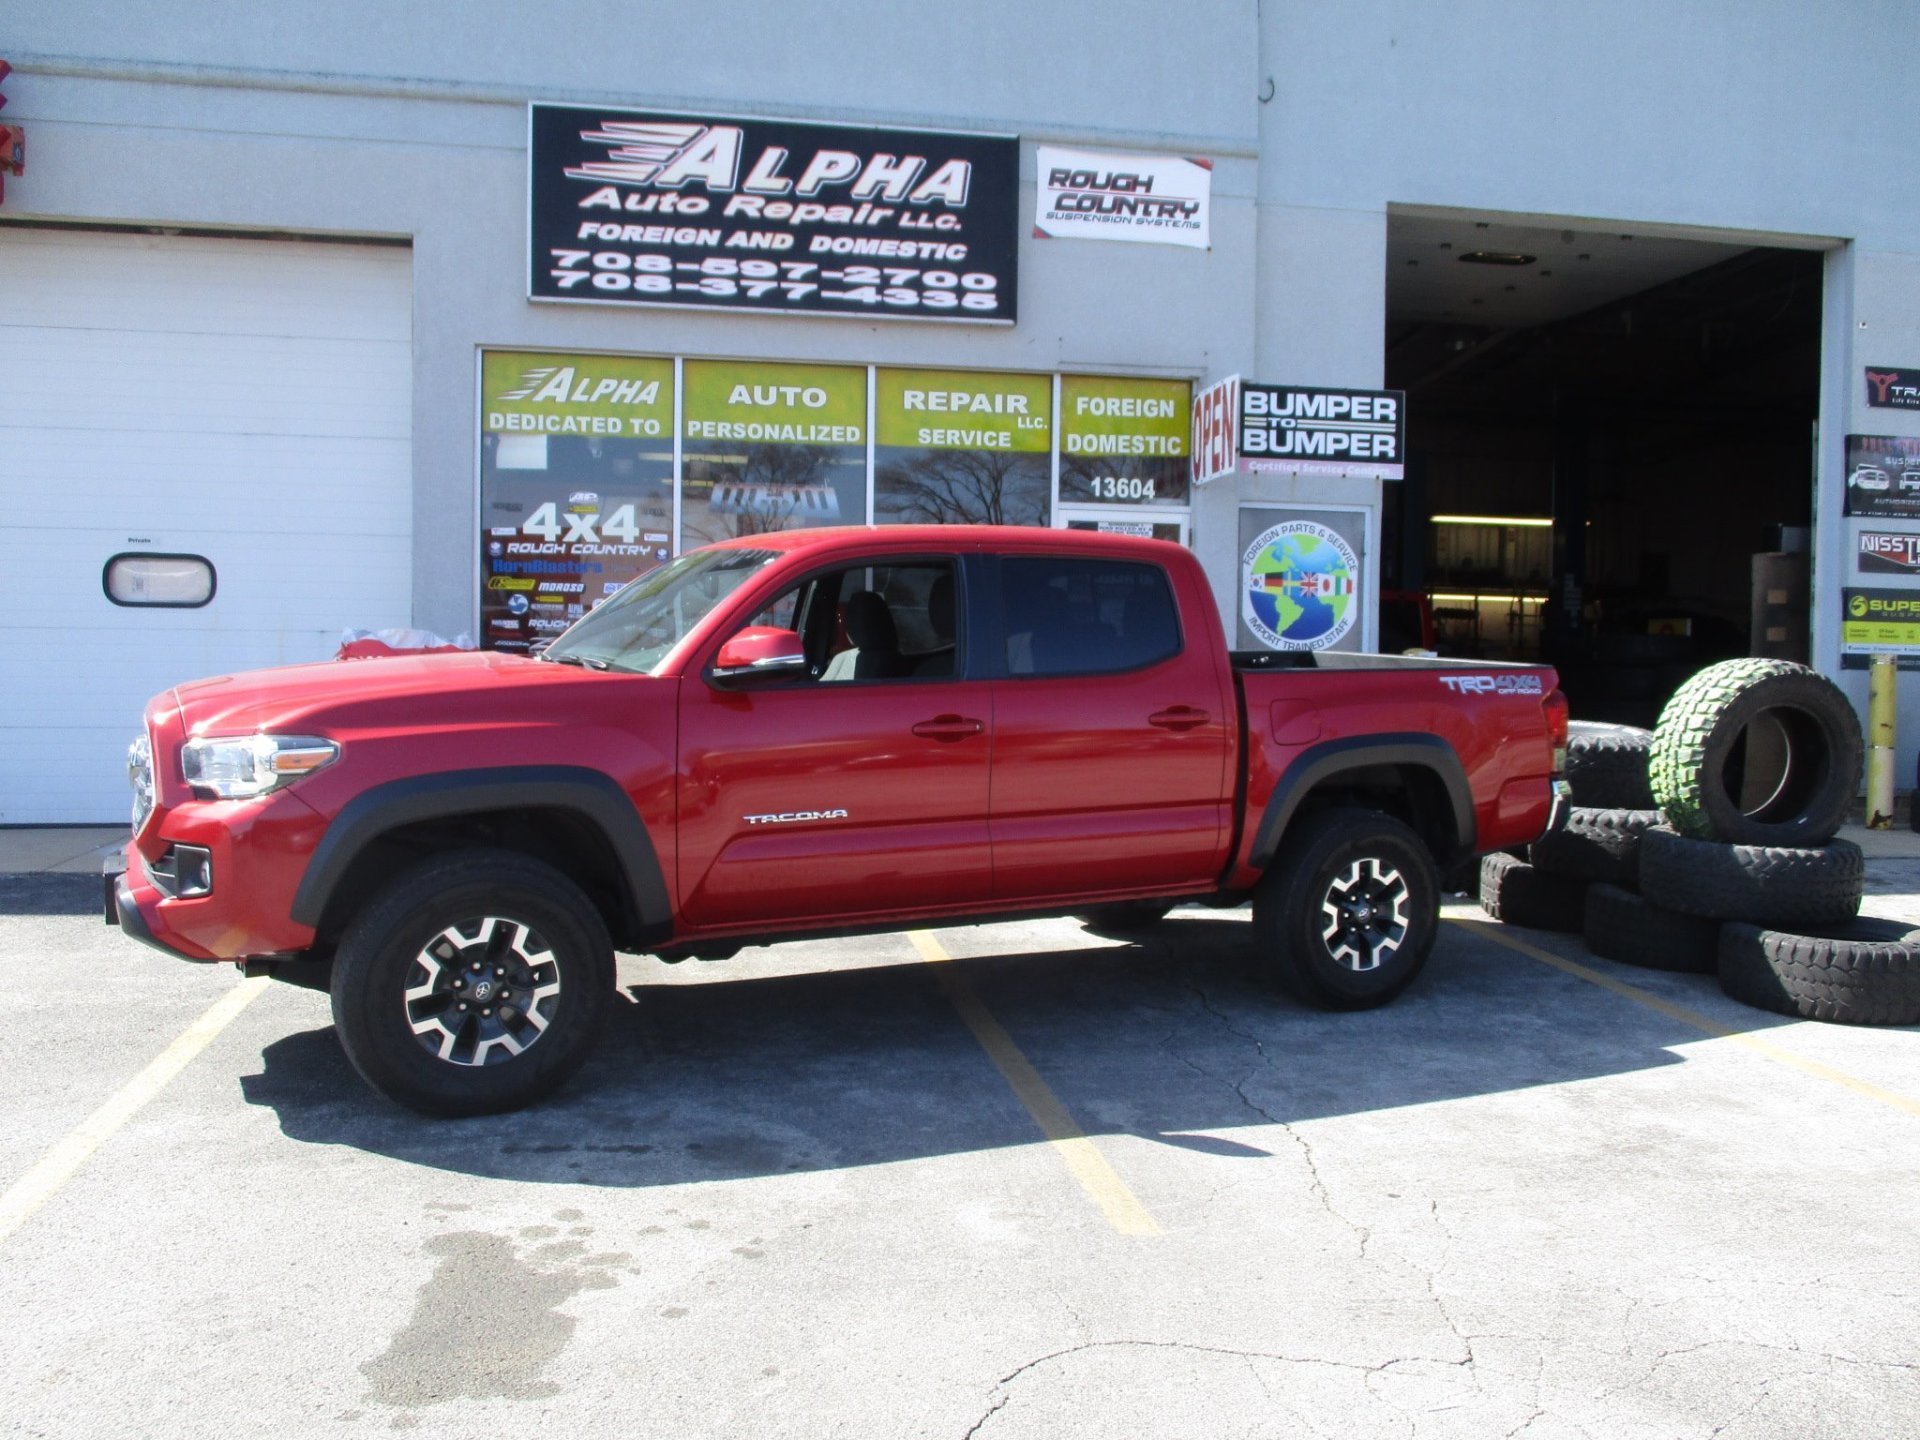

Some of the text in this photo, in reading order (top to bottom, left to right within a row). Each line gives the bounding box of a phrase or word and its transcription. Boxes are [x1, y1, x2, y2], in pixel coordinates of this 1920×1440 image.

[654, 124, 971, 206] ALPHA
[1048, 167, 1155, 193] ROUGH
[579, 187, 962, 231] Auto Repair LLC.
[1054, 192, 1200, 220] COUNTRY
[1045, 211, 1201, 230] SUSPENSION SYSTEMS
[578, 223, 968, 261] FOREIGN AND DOMESTIC
[550, 250, 998, 289] 708-597-2700
[550, 270, 998, 309] 708-377-4335
[532, 366, 660, 404] ALPHA
[728, 384, 827, 408] AUTO
[903, 390, 1028, 414] REPAIR
[1077, 397, 1175, 419] FOREIGN
[1244, 391, 1397, 421] BUMPER
[489, 412, 661, 435] DEDICATED TO
[687, 420, 861, 443] PERSONALIZED
[1017, 417, 1048, 430] LLC.
[1192, 379, 1237, 483] OPEN
[1268, 418, 1296, 428] TO
[918, 428, 1011, 448] SERVICE
[1067, 433, 1182, 455] DOMESTIC
[1243, 428, 1396, 458] BUMPER
[1091, 476, 1156, 499] 13604
[522, 502, 640, 544] 4x4
[507, 543, 651, 556] ROUGH COUNTRY
[1243, 523, 1358, 572] FOREIGN PARTS & SERVICE
[528, 619, 570, 628] ROUGH
[1249, 616, 1350, 651] IMPORT TRAINED STAFF
[1439, 676, 1495, 694] TRD
[743, 809, 848, 824] TACOMA
